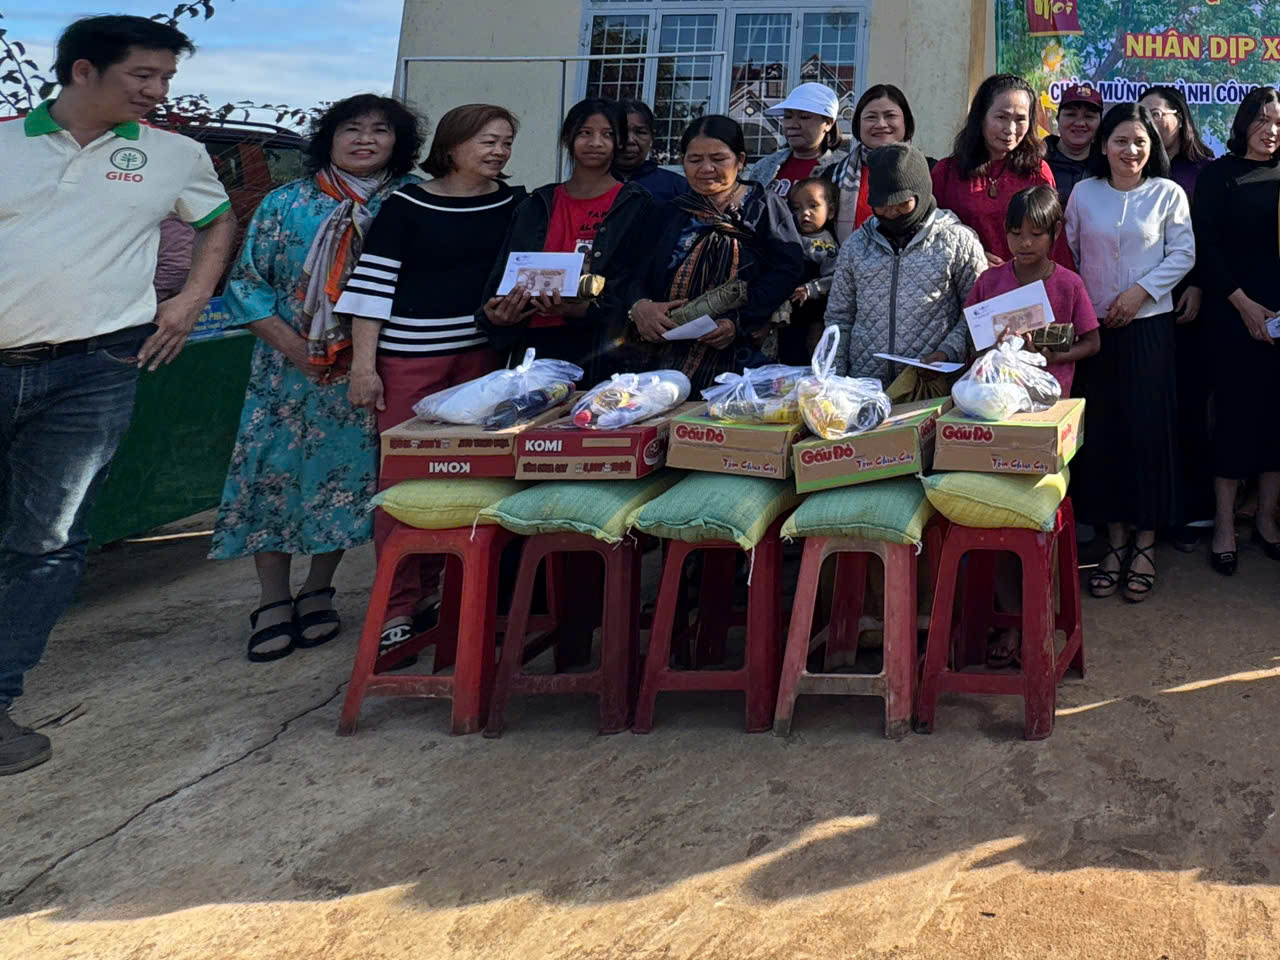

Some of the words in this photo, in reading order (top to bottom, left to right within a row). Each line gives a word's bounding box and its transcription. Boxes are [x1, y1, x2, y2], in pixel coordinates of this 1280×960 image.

[1125, 29, 1200, 58] NHÂN
[1210, 36, 1256, 65] DỊP
[1215, 80, 1259, 103] CÔN
[105, 171, 144, 183] GIEO
[524, 439, 563, 452] KOMI
[429, 462, 470, 473] KOMI
